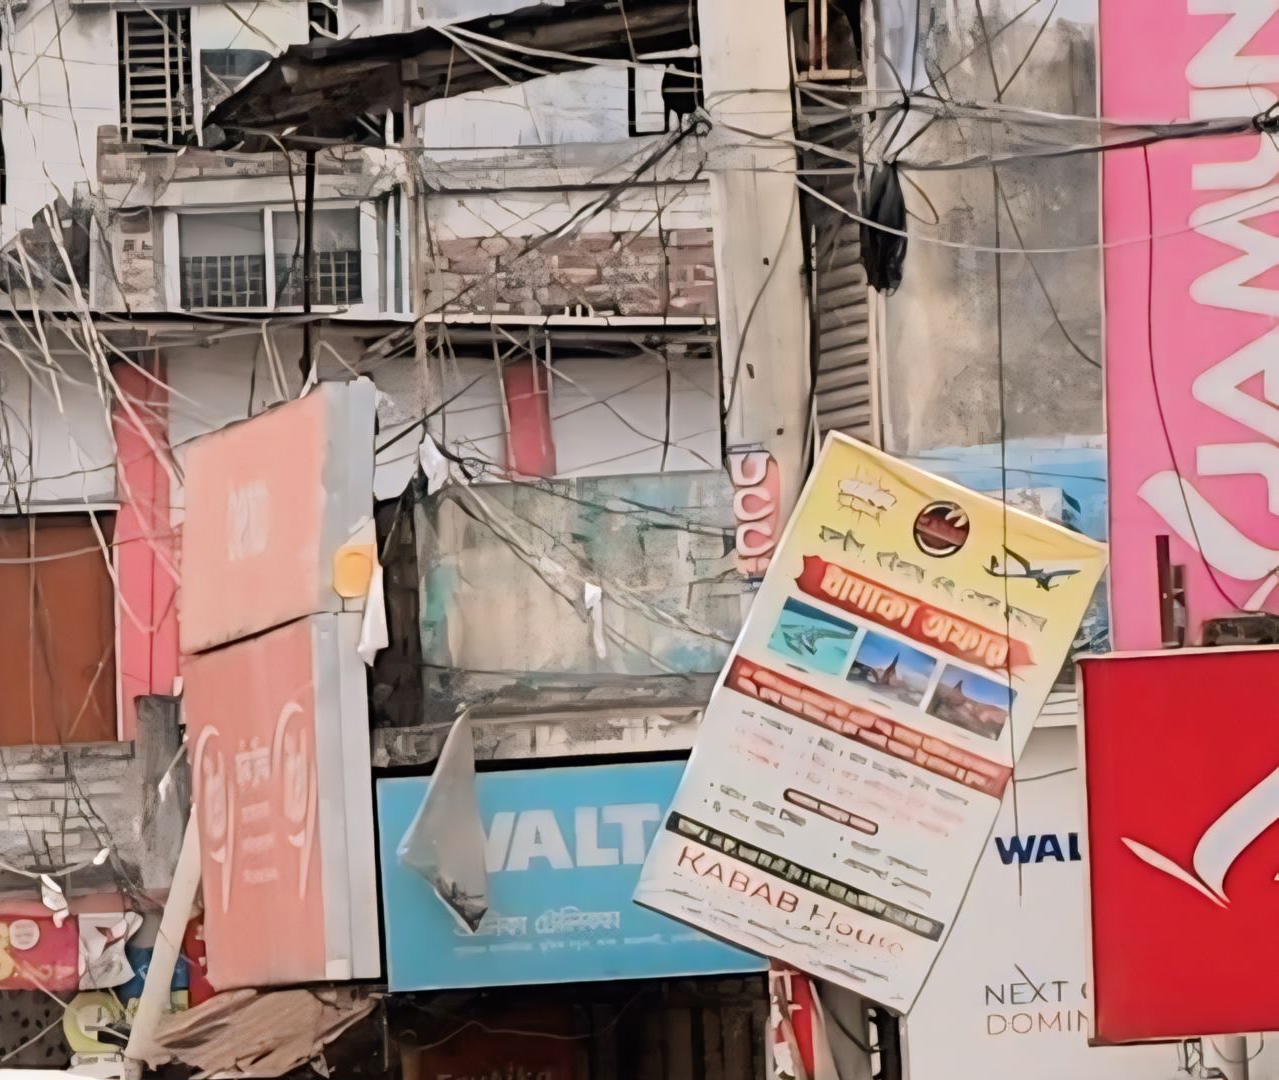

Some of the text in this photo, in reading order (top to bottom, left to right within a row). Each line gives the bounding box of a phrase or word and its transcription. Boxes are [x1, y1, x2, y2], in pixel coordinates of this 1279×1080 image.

[484, 803, 660, 873] ALT
[995, 832, 1081, 865] WAL
[677, 846, 799, 912] KABAB
[985, 981, 1069, 1006] NEXT
[987, 1010, 1089, 1036] DOMIN
